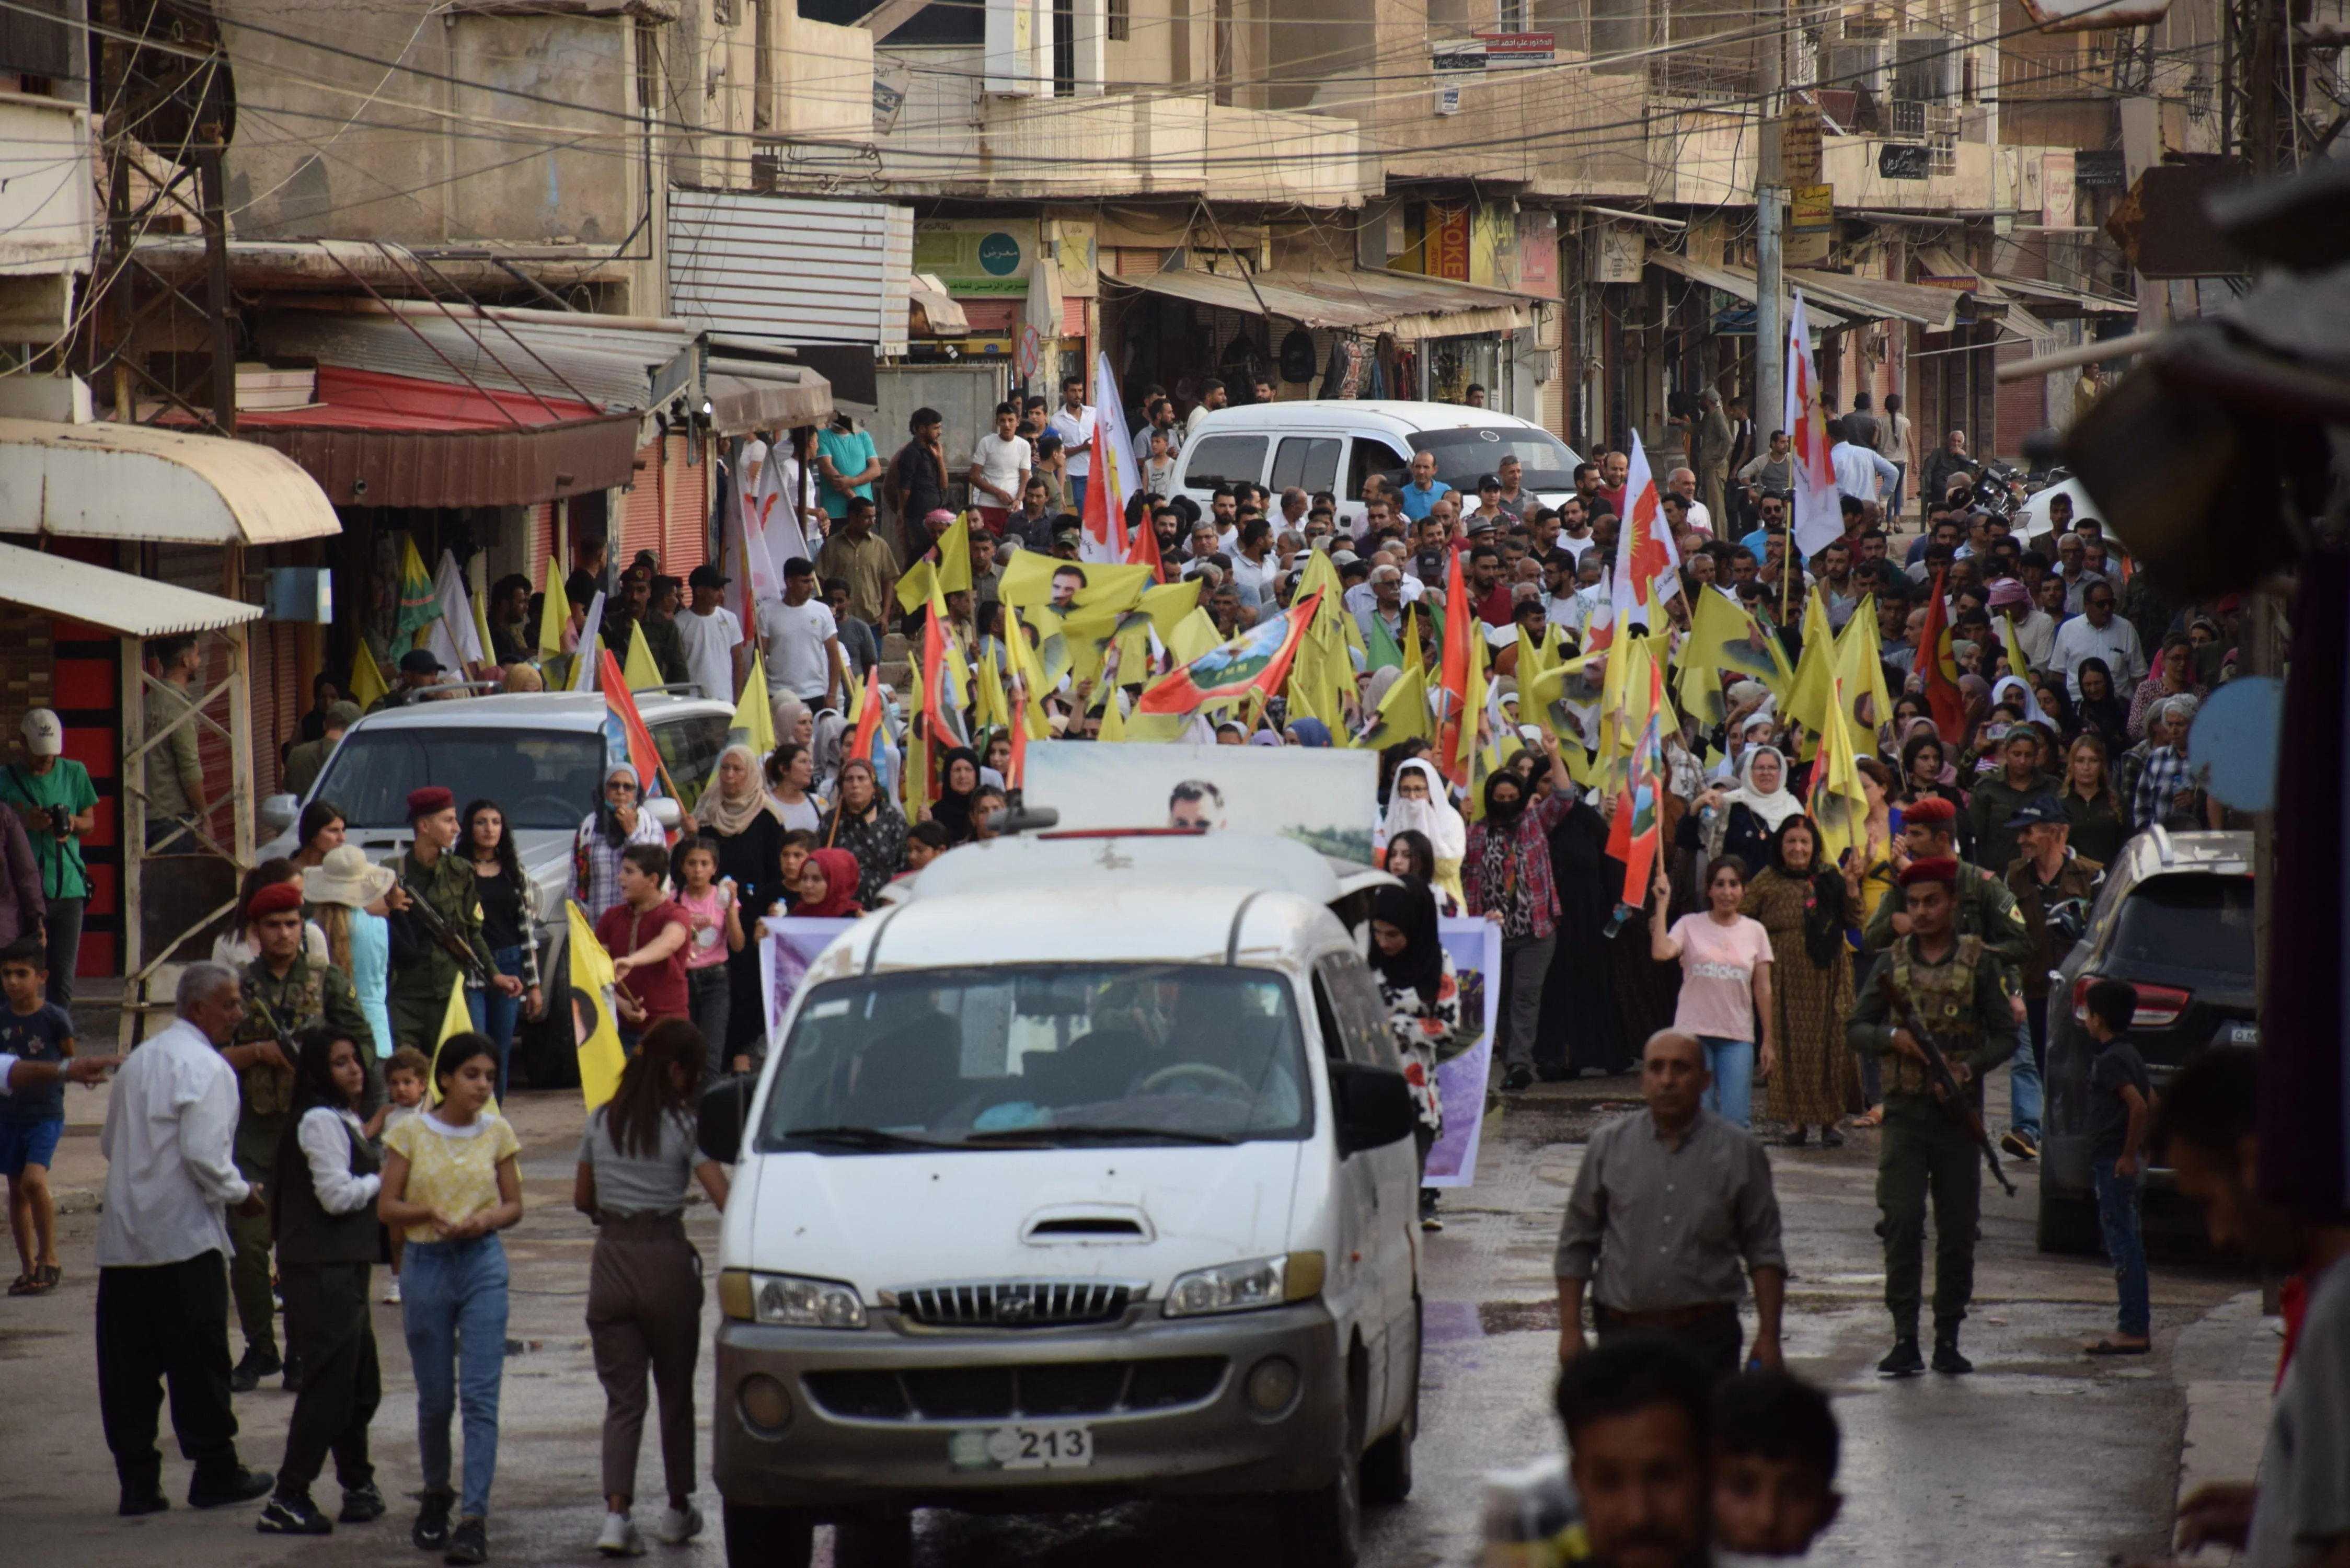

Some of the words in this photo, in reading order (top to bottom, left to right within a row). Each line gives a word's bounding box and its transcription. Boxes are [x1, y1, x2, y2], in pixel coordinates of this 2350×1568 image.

[1516, 39, 1528, 49] علي
[1529, 39, 1552, 48] الدكتور
[1798, 187, 1829, 202] صيدلية
[983, 247, 1018, 259] معرض
[1020, 1429, 1085, 1458] 213
